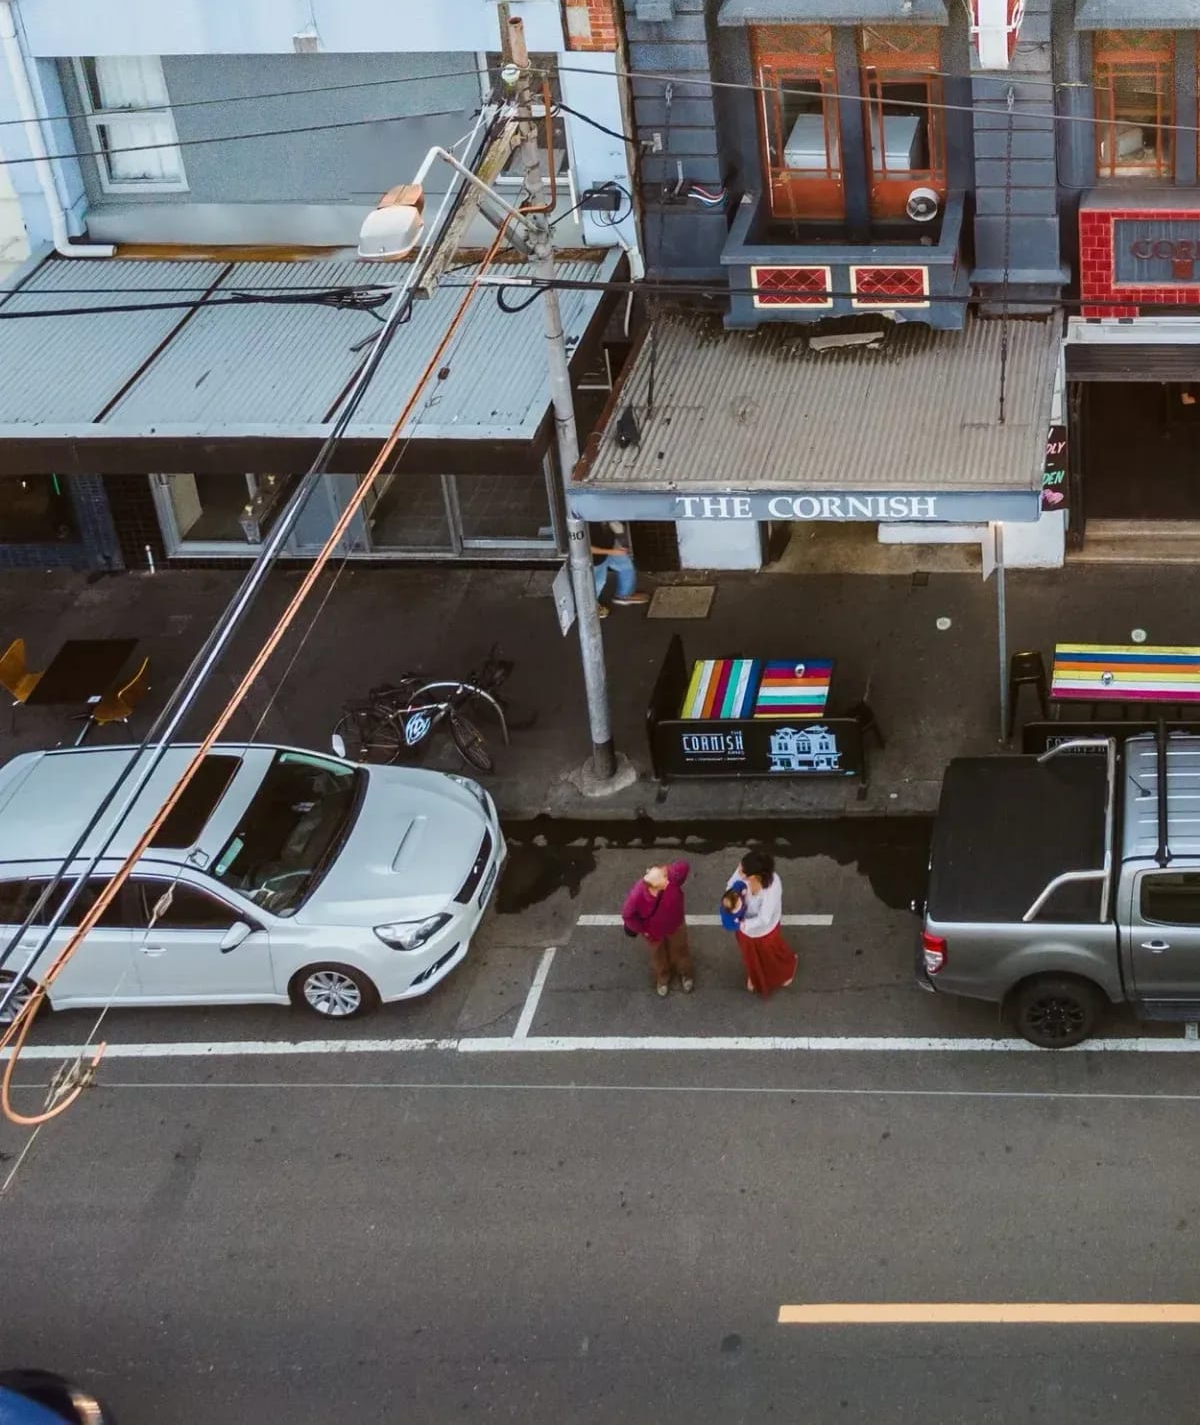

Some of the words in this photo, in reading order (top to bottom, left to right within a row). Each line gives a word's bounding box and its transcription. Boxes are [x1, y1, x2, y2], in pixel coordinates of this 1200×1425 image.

[675, 496, 752, 518] THE
[767, 496, 938, 519] CORNISH
[682, 735, 744, 751] CORNISH
